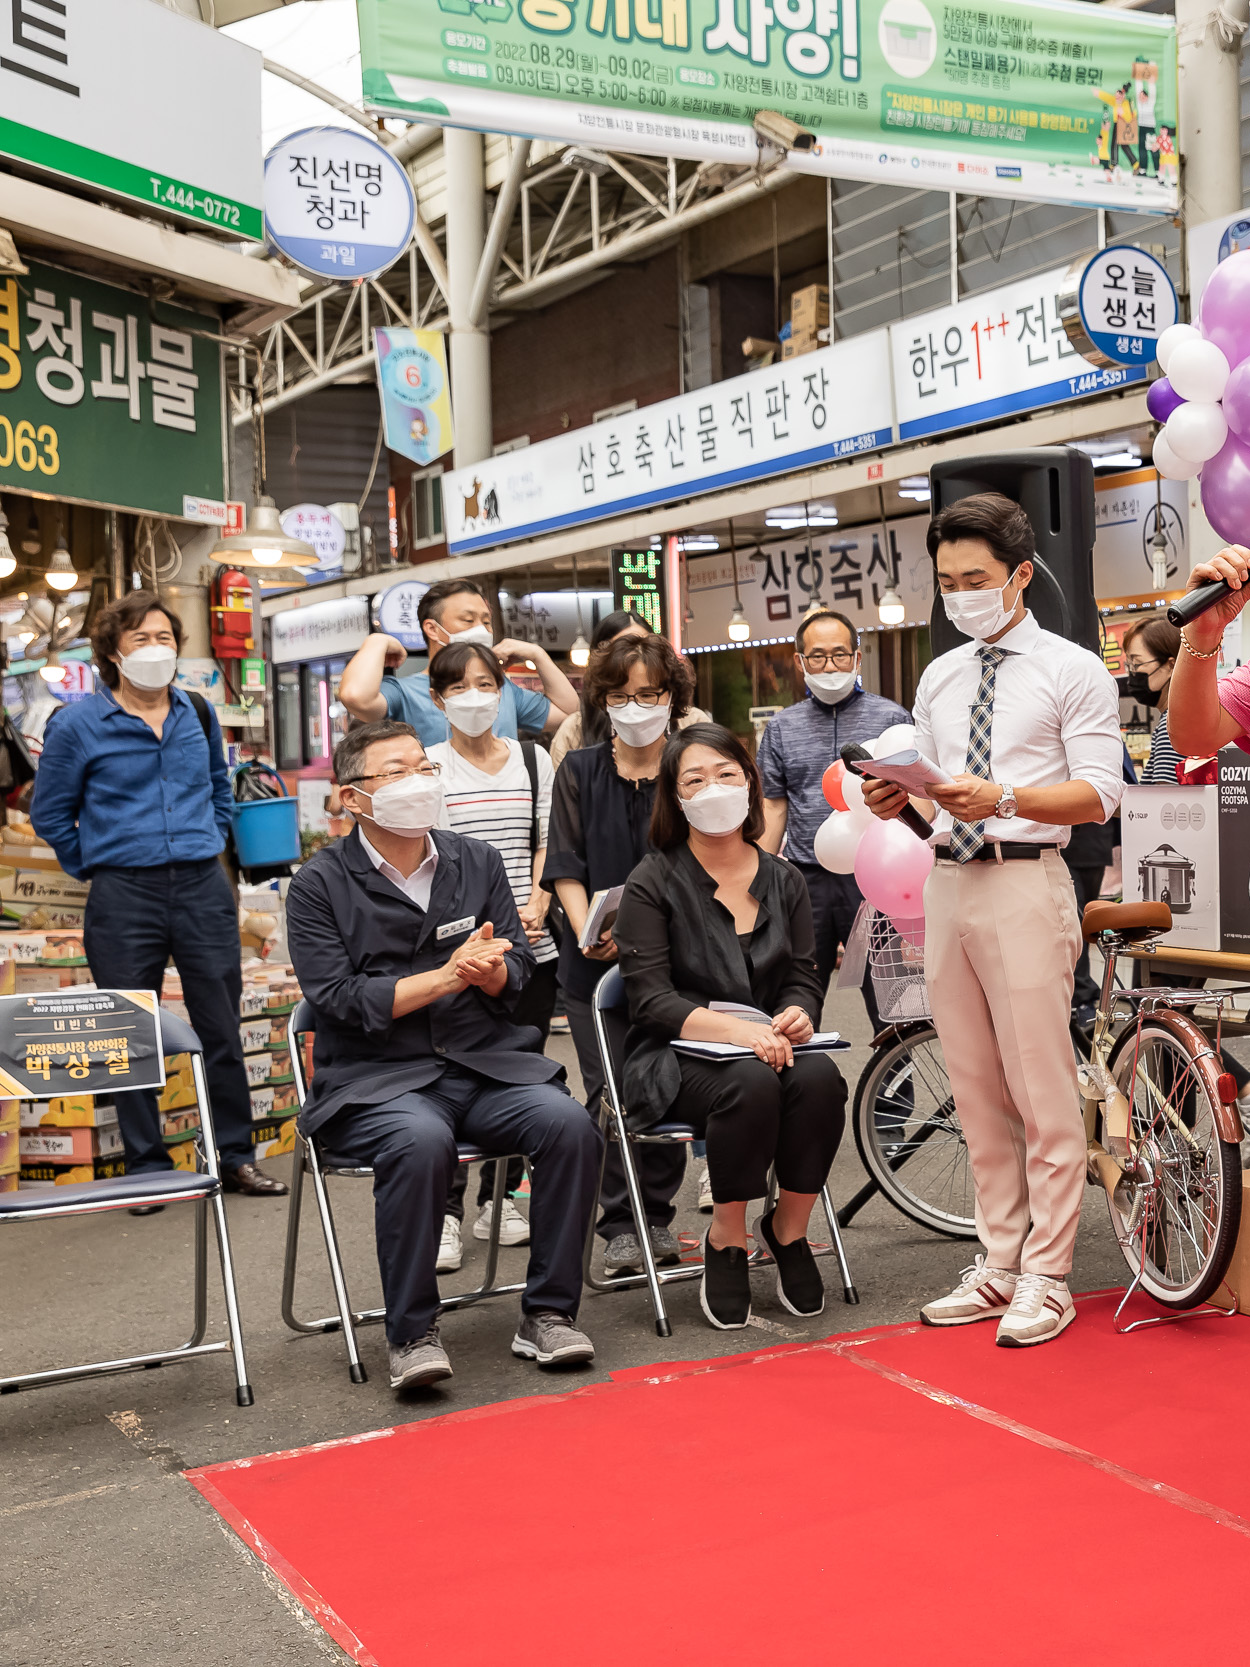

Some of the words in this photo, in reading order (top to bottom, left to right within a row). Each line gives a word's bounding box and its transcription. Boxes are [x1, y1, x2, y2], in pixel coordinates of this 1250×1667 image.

[943, 24, 973, 43] 5만원
[976, 29, 998, 48] 이상
[1001, 34, 1024, 50] 구매
[565, 74, 595, 98] 오후
[723, 71, 798, 99] 자양전통시장
[801, 82, 850, 107] 고객쉼터
[288, 154, 384, 198] 진선명
[305, 196, 371, 232] 청과
[320, 243, 357, 267] 과일
[1103, 263, 1156, 297] 오늘
[1103, 298, 1156, 332] 생선
[1115, 336, 1143, 355] 생선
[405, 364, 422, 388] 6
[1221, 786, 1247, 795] COZYMA
[1221, 795, 1249, 805] FOOTSPA
[25, 1041, 86, 1056] 자양전통시장
[87, 1037, 129, 1053] 상인회장
